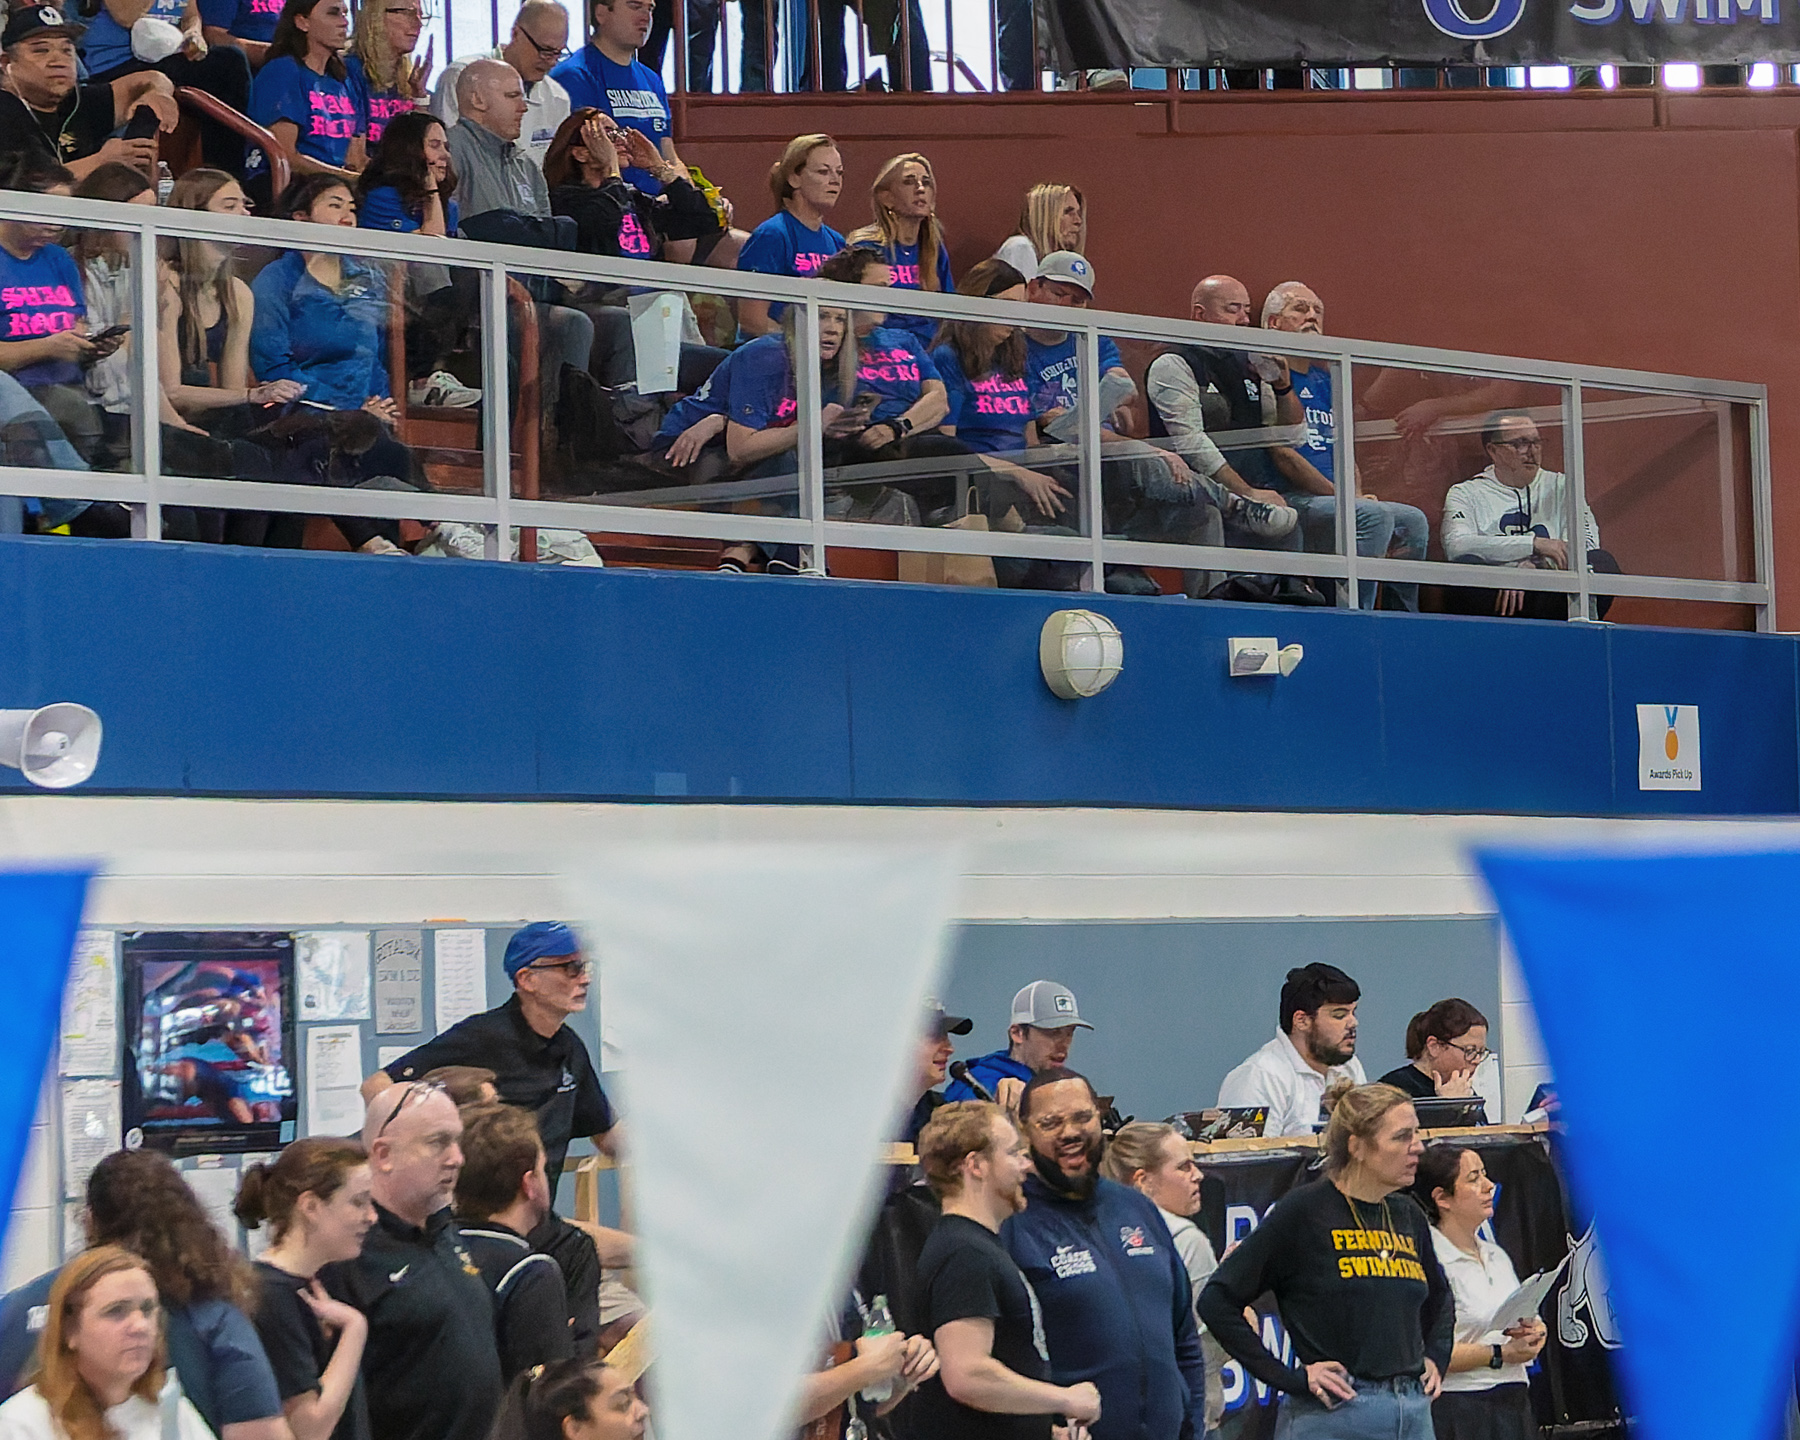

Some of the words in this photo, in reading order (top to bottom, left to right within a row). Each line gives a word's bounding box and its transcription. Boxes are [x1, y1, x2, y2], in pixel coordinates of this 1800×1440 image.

[1649, 768, 1671, 780] Awards
[1672, 768, 1683, 779] Pick
[1684, 768, 1692, 781] Up
